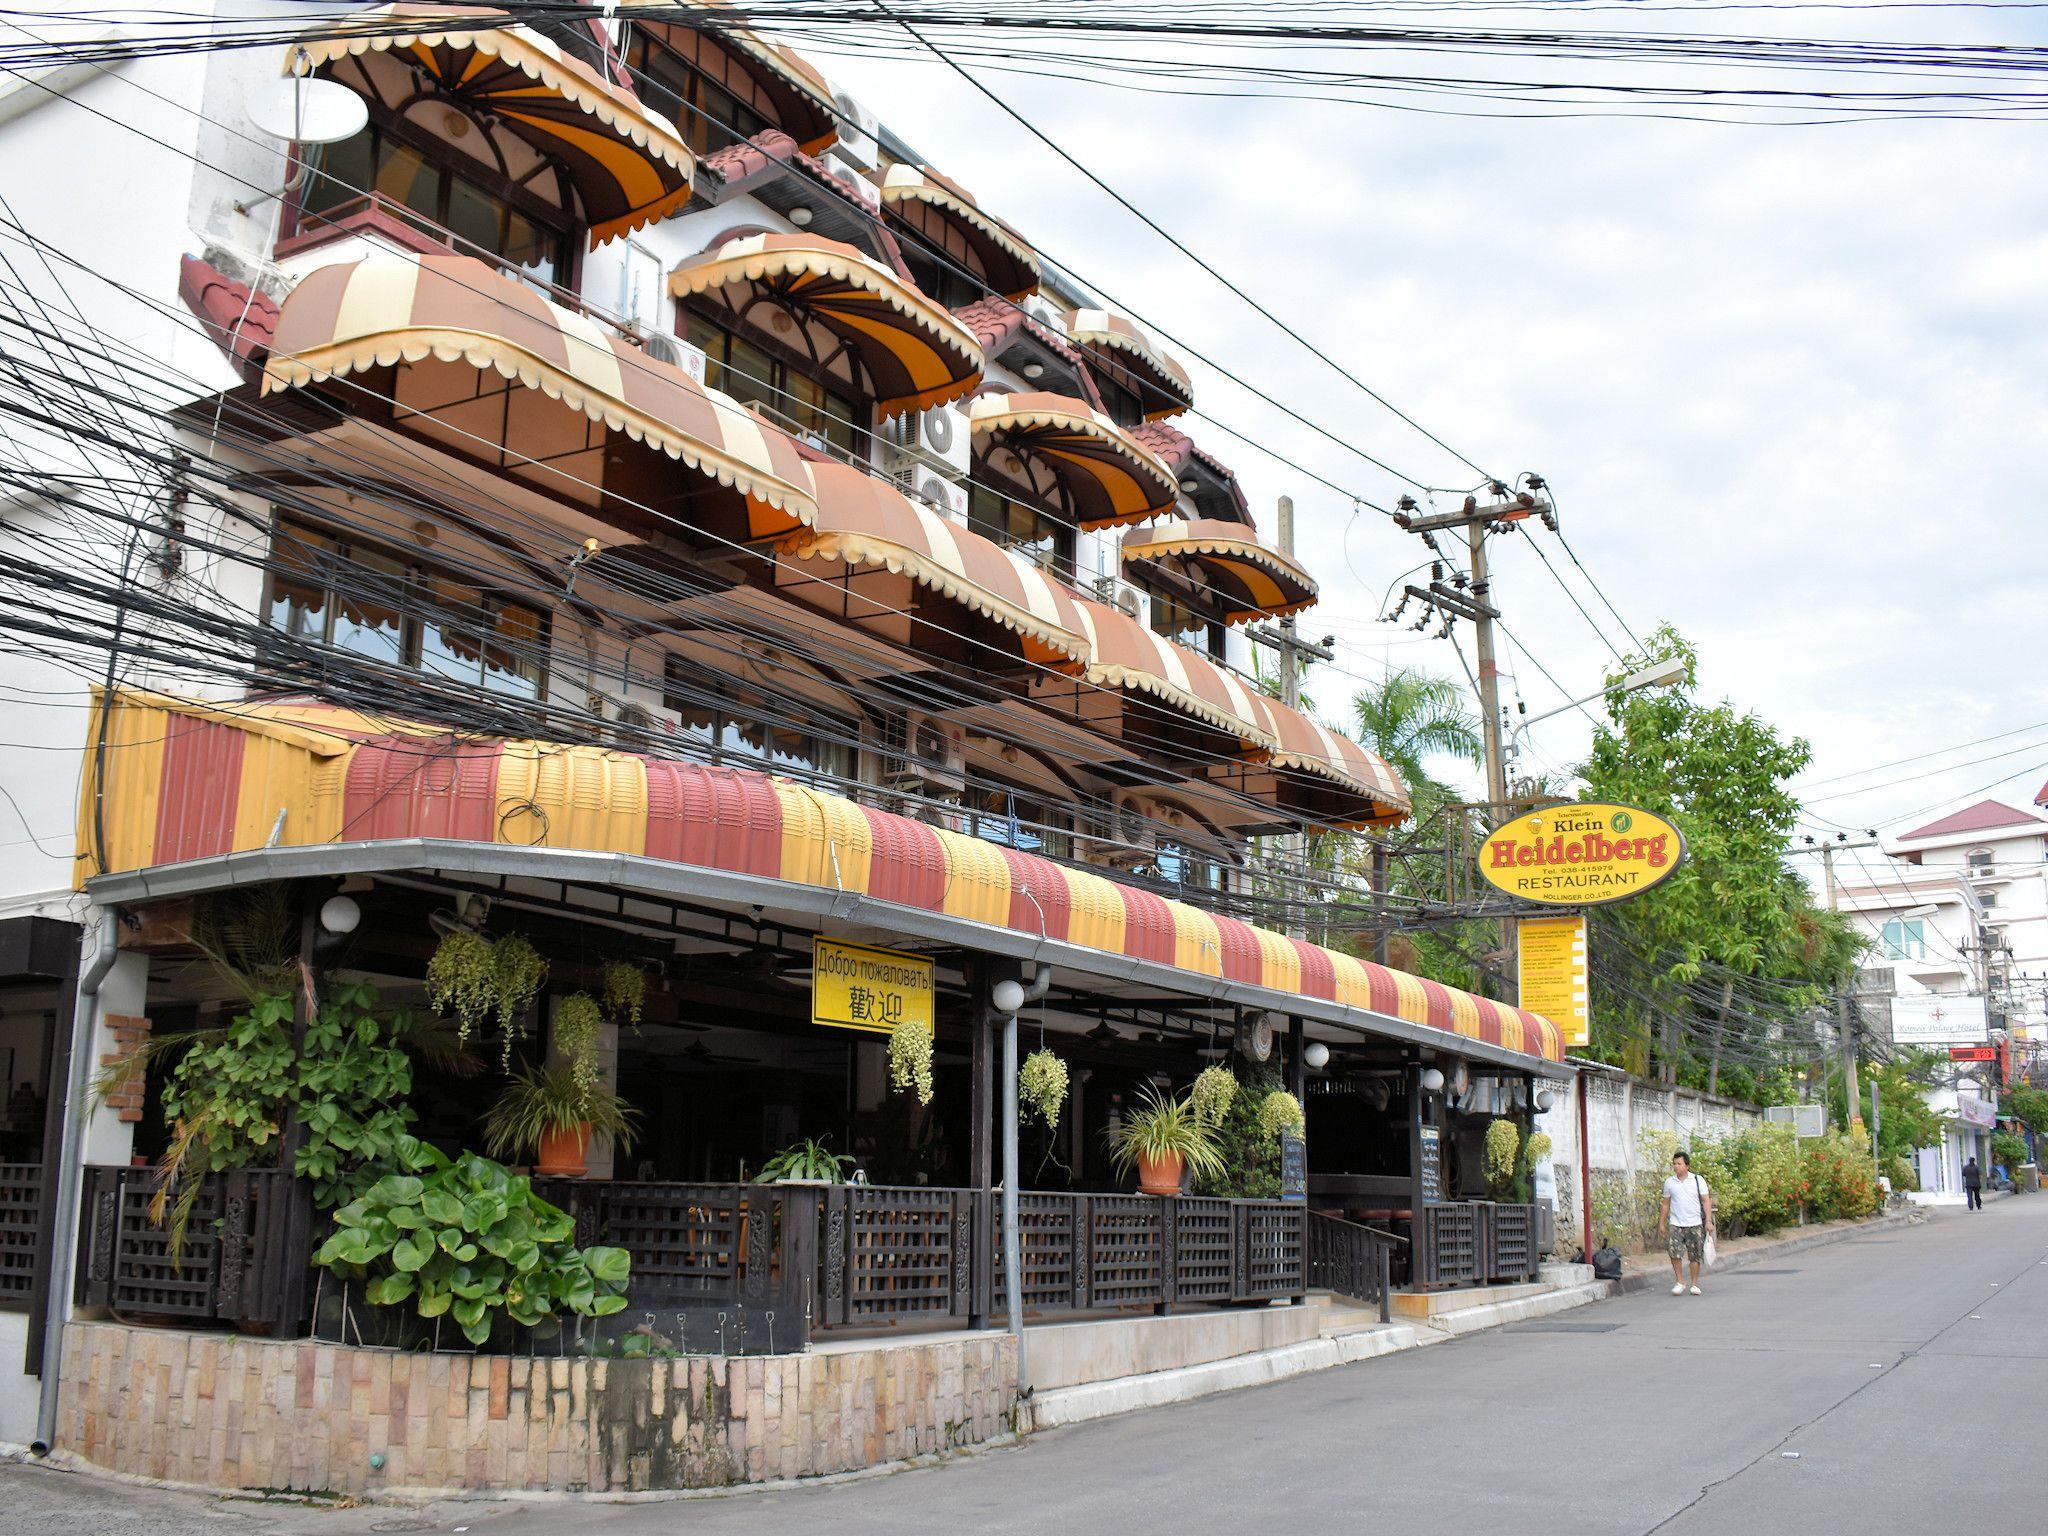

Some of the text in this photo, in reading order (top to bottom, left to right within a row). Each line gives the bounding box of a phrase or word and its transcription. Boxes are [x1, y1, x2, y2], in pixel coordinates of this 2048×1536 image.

[1554, 818, 1604, 833] Klein
[1490, 832, 1669, 868] Heidelberg
[1561, 865, 1614, 874] 038-415979
[1518, 872, 1640, 890] RESTAURANT
[1543, 893, 1582, 901] HOLLINGER
[818, 947, 932, 990] Добро пожаловать!
[848, 985, 903, 1025] 歡迎
[1956, 1023, 1981, 1032] Hotel
